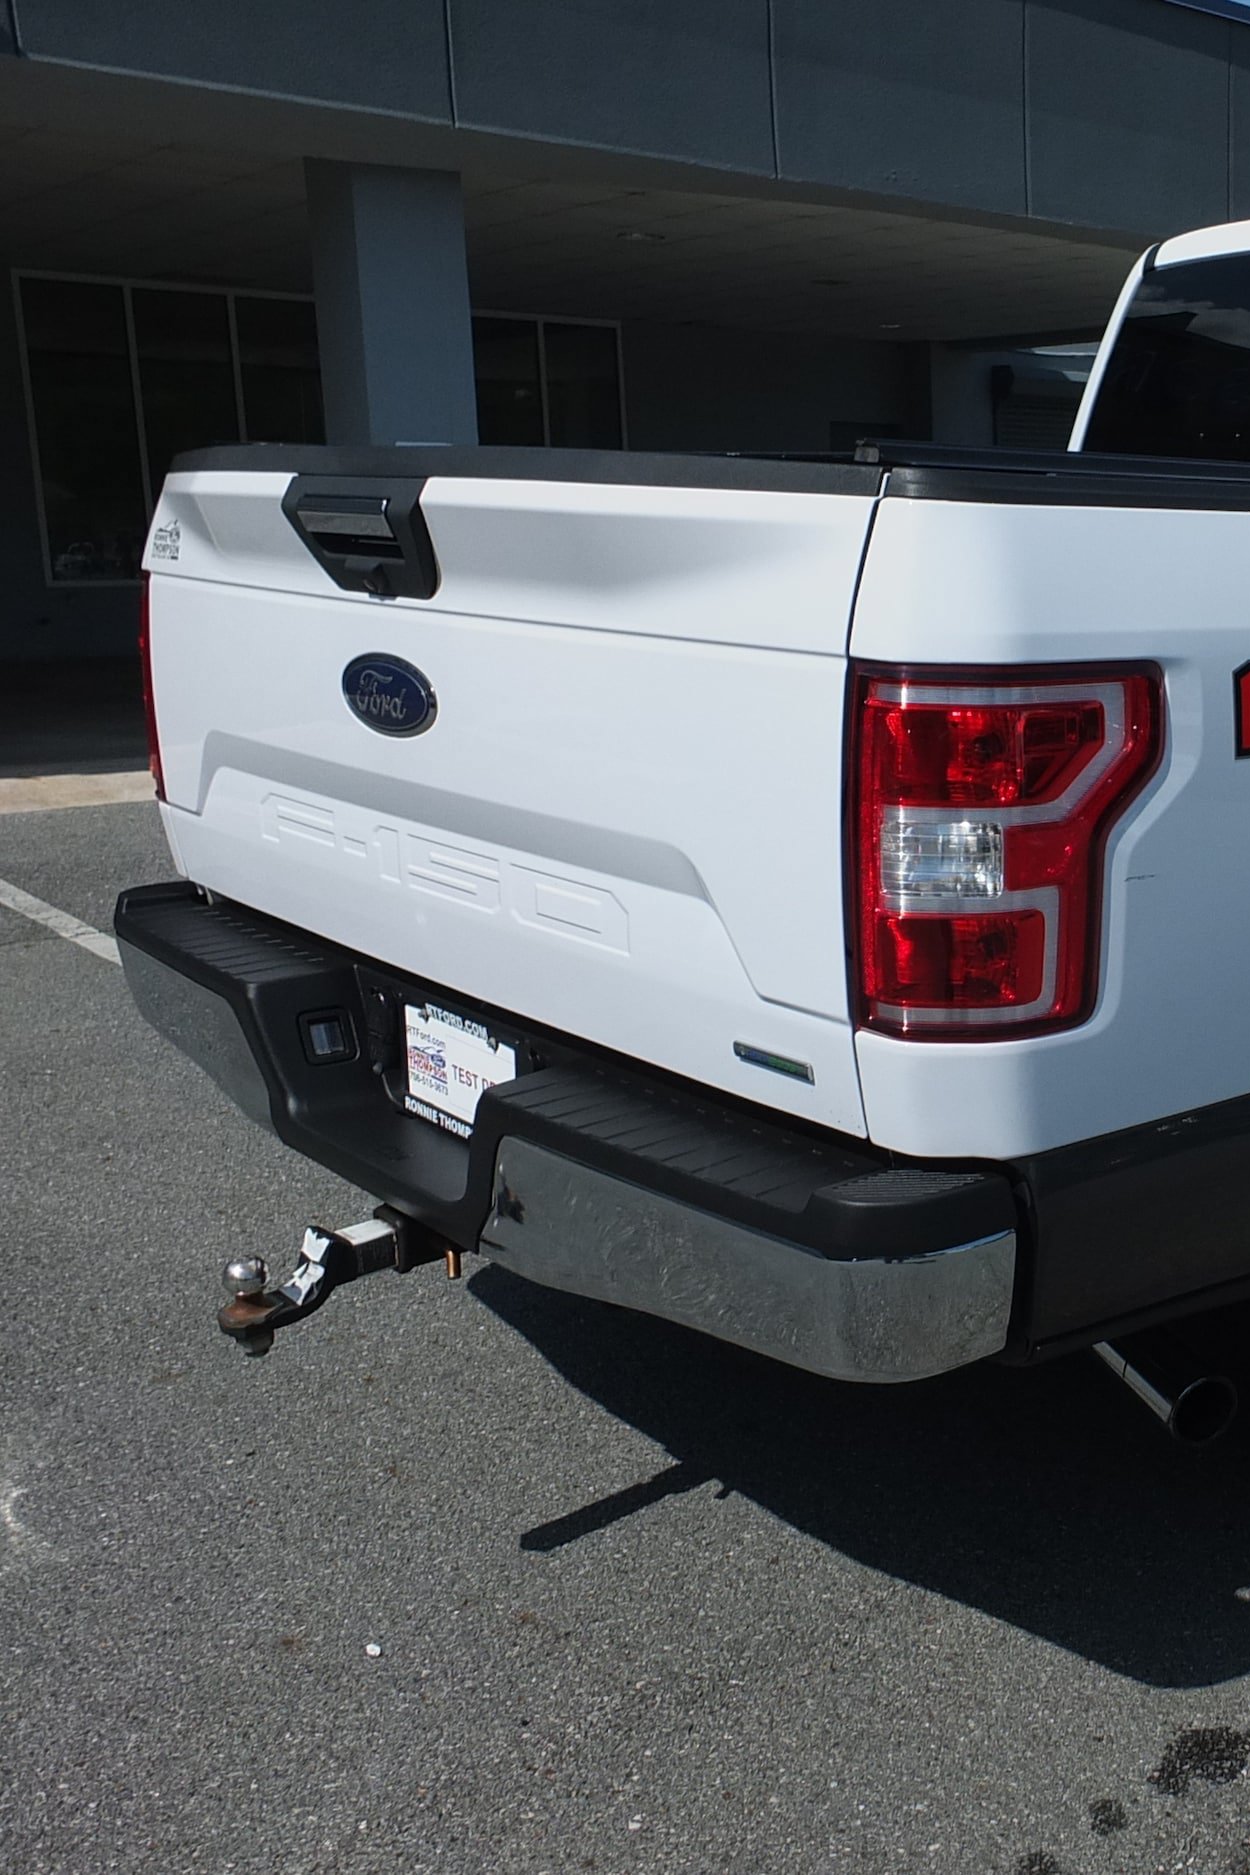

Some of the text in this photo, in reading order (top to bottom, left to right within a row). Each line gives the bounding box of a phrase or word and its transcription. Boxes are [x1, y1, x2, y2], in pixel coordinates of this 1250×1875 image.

[356, 668, 408, 721] Ford
[260, 792, 631, 957] F-150
[451, 1064, 478, 1091] TEST
[404, 1096, 473, 1140] RONNIE THOMP
